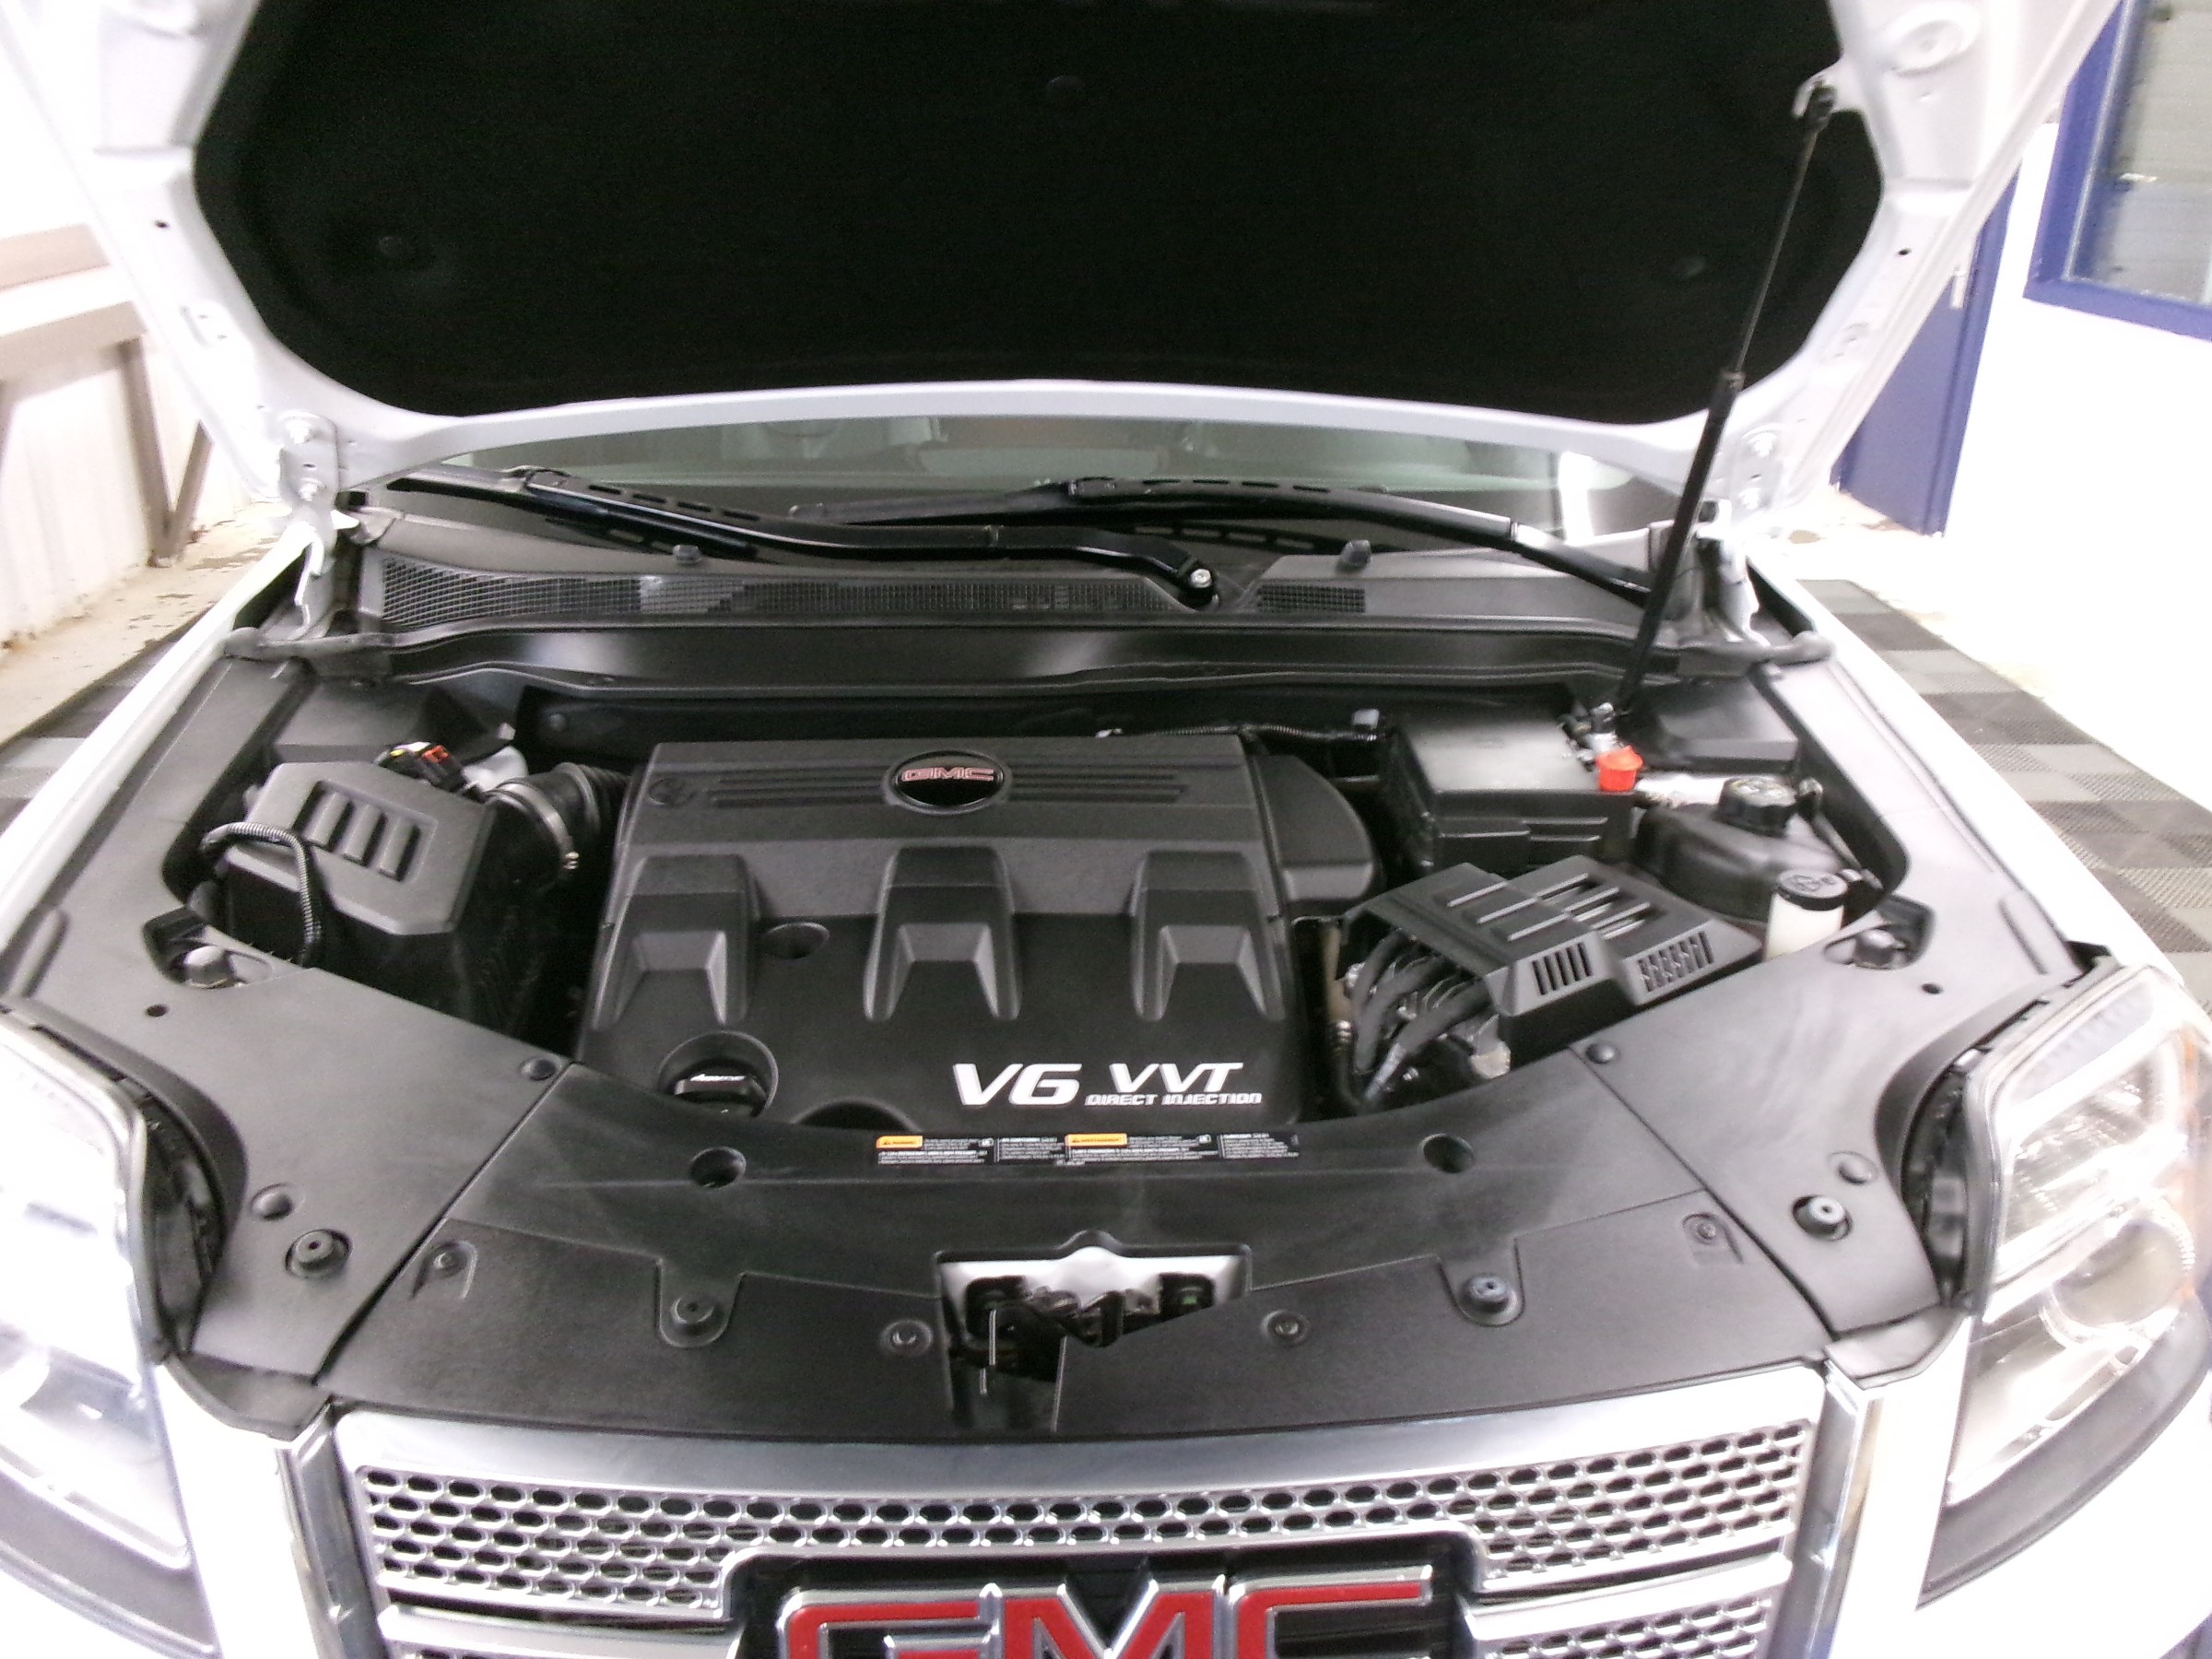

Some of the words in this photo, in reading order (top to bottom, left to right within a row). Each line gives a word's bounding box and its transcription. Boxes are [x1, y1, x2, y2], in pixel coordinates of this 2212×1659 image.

[901, 767, 994, 782] GMC
[952, 1063, 1083, 1106] V6
[1109, 1063, 1244, 1093] VVT
[1084, 1094, 1158, 1106] DIRECT
[1161, 1093, 1263, 1106] INJECTION
[780, 1565, 1432, 1659] GMC
